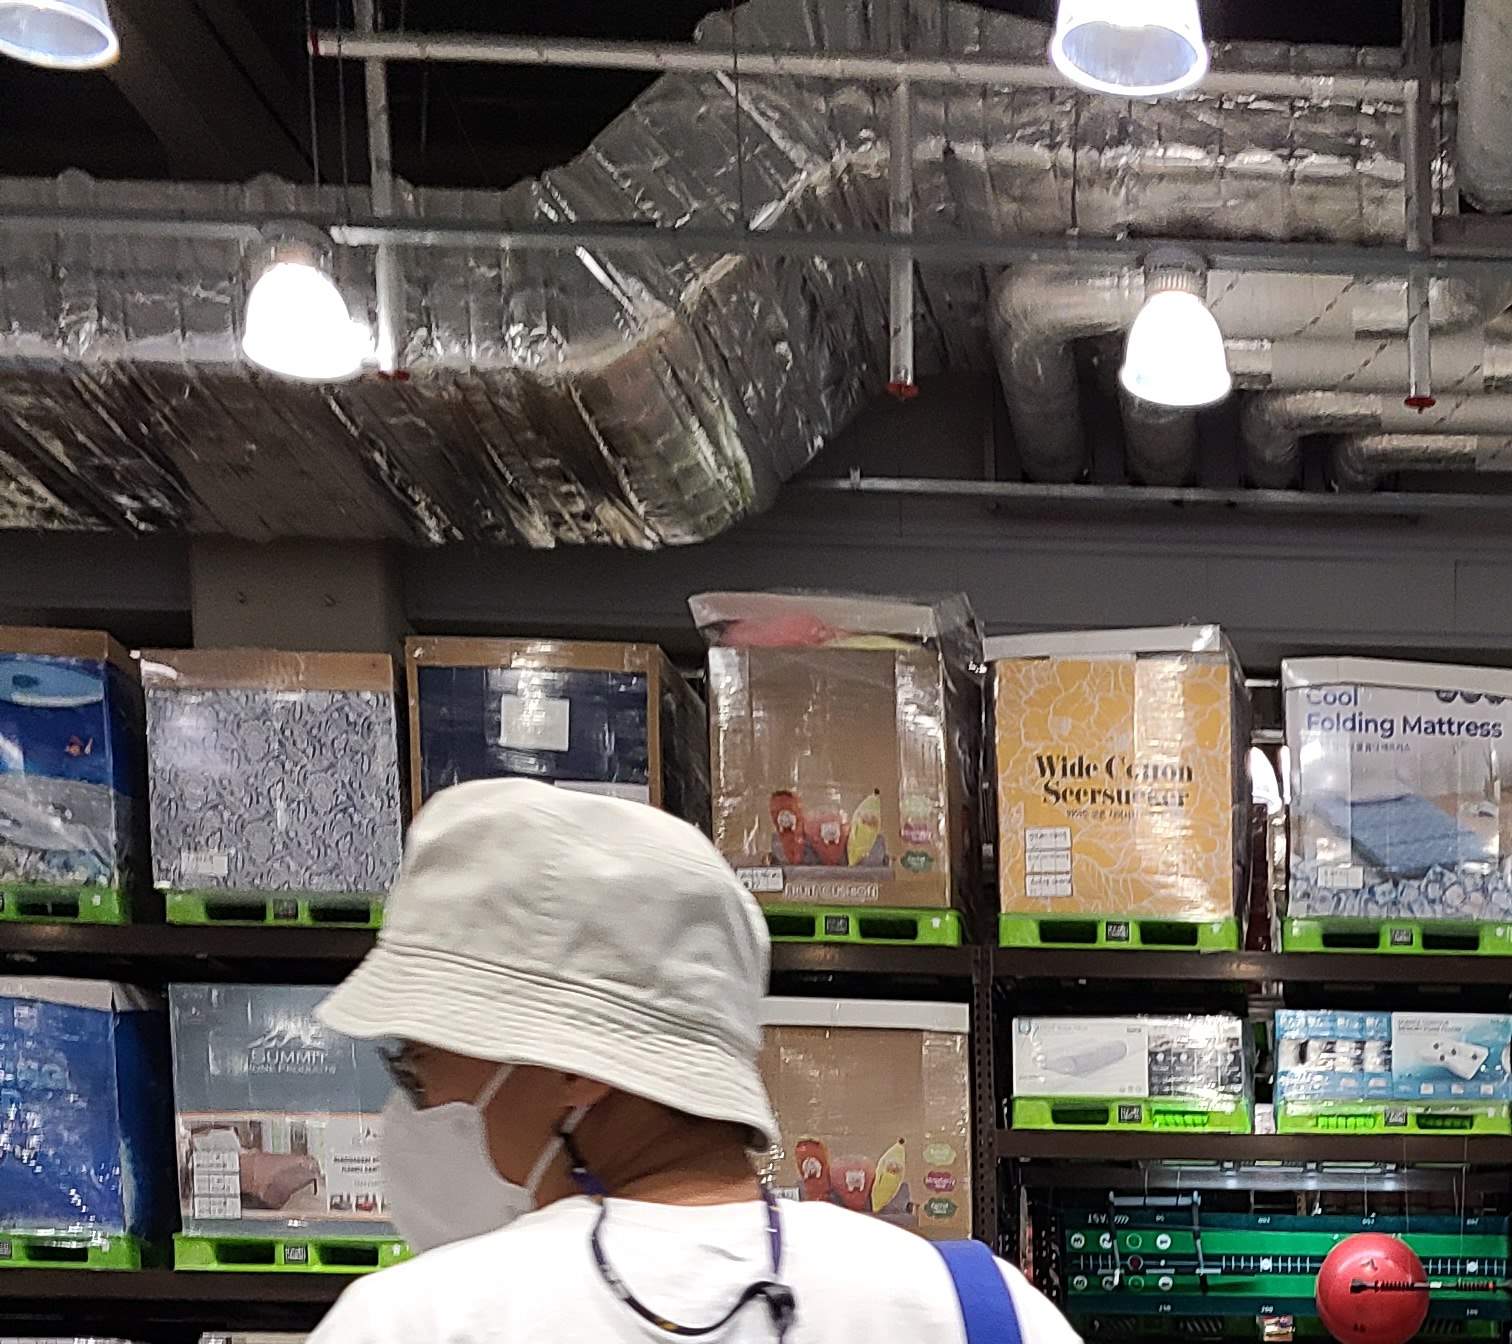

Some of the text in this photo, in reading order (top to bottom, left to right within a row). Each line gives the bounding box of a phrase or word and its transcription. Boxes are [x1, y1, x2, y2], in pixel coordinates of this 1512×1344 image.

[1306, 685, 1359, 706] Cool
[1307, 711, 1504, 740] Folding Mattress
[1036, 754, 1099, 779] Wide
